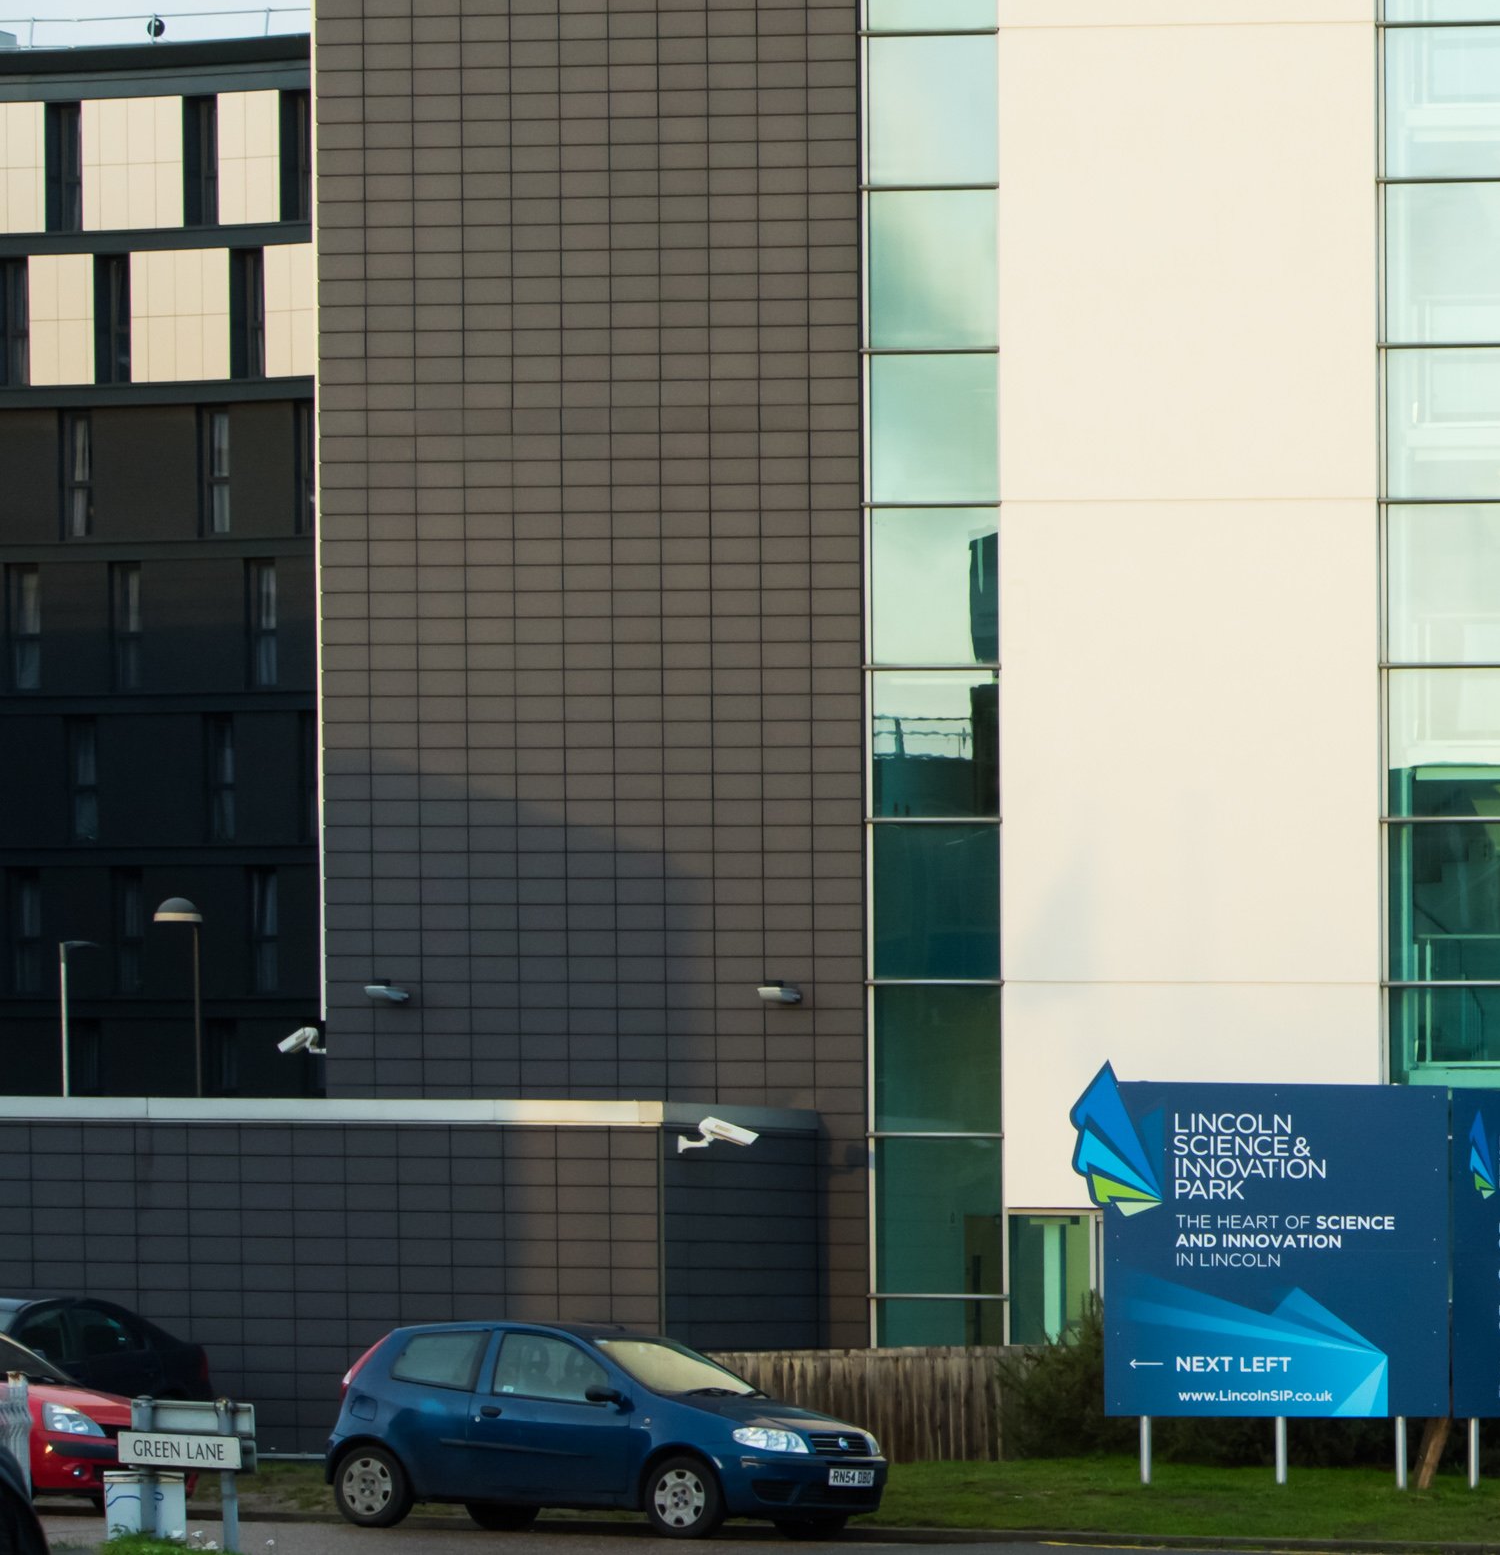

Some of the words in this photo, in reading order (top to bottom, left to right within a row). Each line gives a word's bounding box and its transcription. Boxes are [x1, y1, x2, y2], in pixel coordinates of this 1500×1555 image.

[1174, 1113, 1292, 1134] LINCOLN
[1173, 1135, 1290, 1157] SCIENCE
[1293, 1136, 1311, 1157] &
[1175, 1157, 1327, 1179] INNOVATION
[1175, 1179, 1245, 1200] PARK
[1175, 1214, 1211, 1229] THE
[1217, 1215, 1279, 1229] HEART
[1285, 1215, 1311, 1230] OF
[1316, 1215, 1395, 1231] SCIENCE
[1175, 1233, 1216, 1248] AND
[1223, 1234, 1342, 1249] INNOVATION
[1176, 1253, 1194, 1266] IN
[1200, 1253, 1281, 1267] LINCOLN
[1175, 1356, 1233, 1372] NEXT
[1240, 1356, 1292, 1373] LEFT
[1178, 1390, 1333, 1402] www.LincolnSIP.co.uk
[133, 1439, 180, 1458] GREEN
[186, 1442, 225, 1461] LANE
[832, 1470, 856, 1484] RN54
